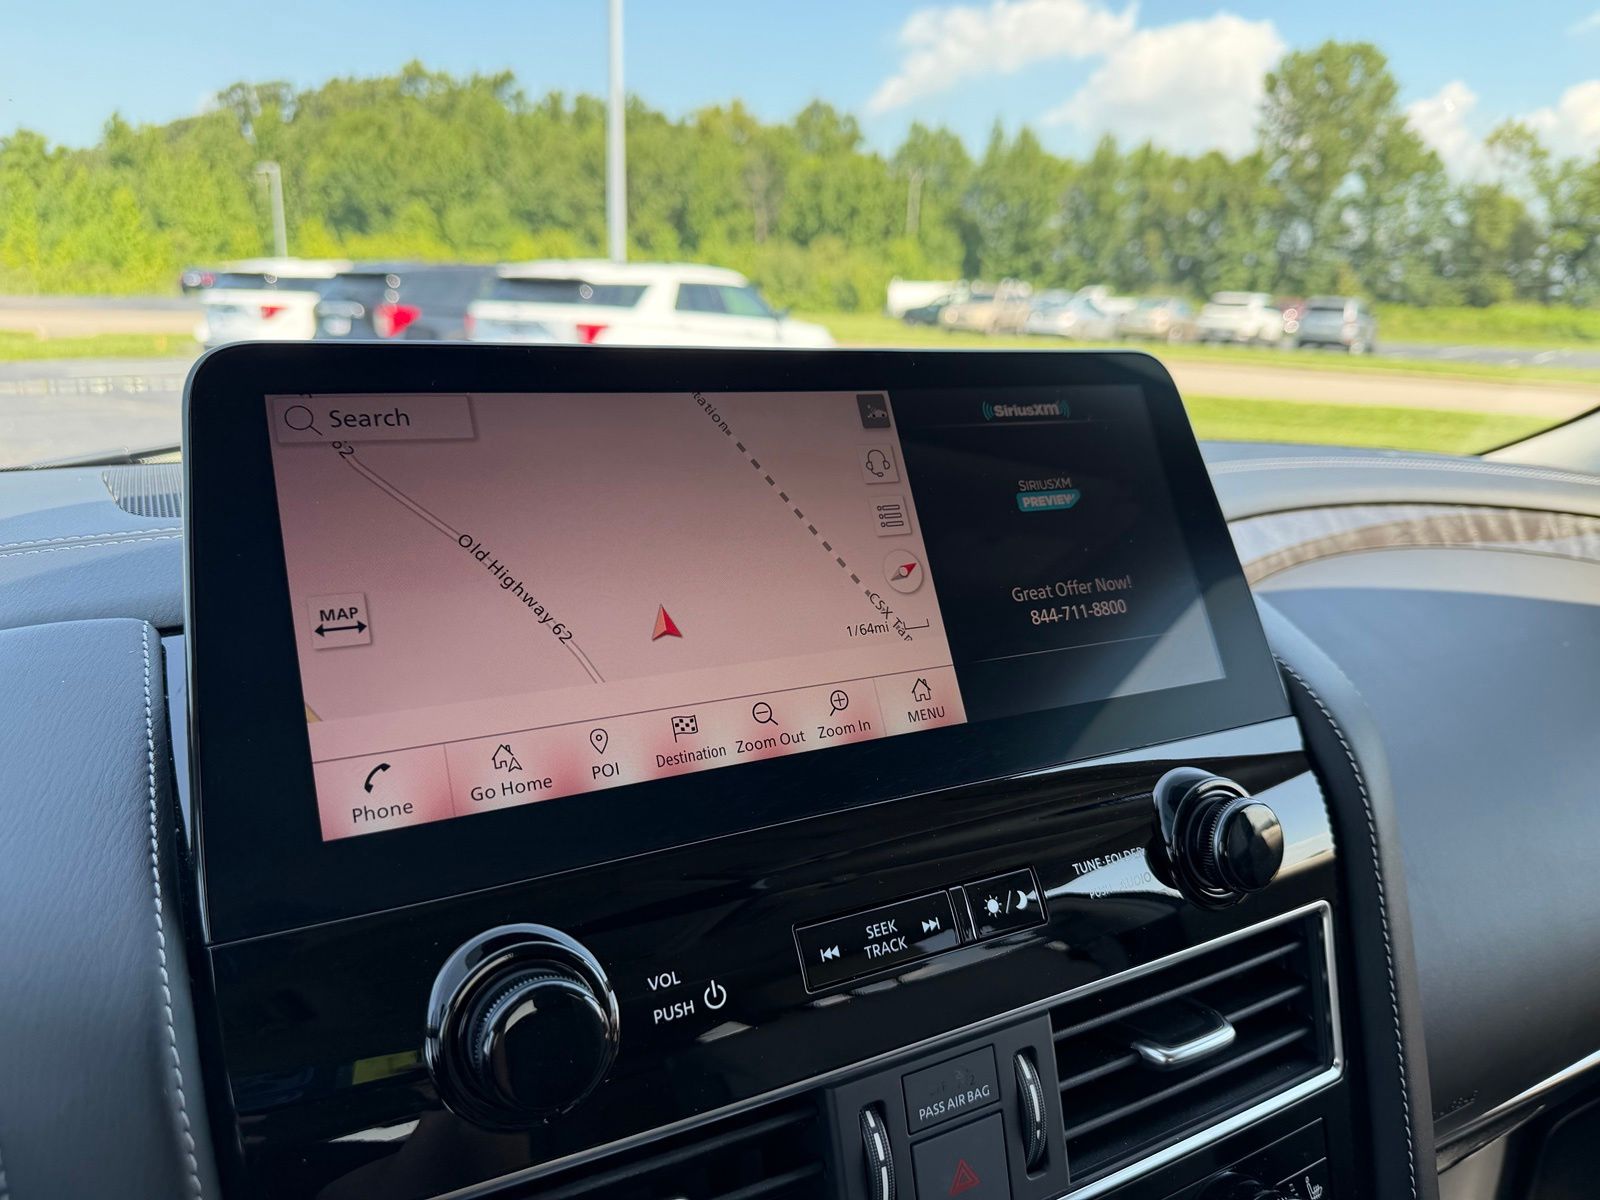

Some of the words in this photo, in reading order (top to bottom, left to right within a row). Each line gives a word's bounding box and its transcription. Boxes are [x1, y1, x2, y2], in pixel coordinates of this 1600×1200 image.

[329, 408, 411, 429] Search
[1018, 477, 1073, 492] SIRIUSXM
[1022, 493, 1076, 508] PREVIEW
[458, 534, 491, 562] Old
[487, 559, 554, 624] Highway
[552, 623, 573, 645] 62
[1011, 585, 1054, 602] Great
[1055, 579, 1092, 597] Offer
[1095, 574, 1133, 592] Now!
[319, 606, 359, 622] MAP
[869, 592, 894, 620] CSX
[1030, 598, 1127, 625] 844-711-8800
[846, 620, 890, 637] 1/64mi
[907, 705, 946, 724] MENU
[817, 722, 857, 739] Zoom
[858, 719, 872, 733] In
[735, 738, 777, 754] Zoom
[779, 730, 807, 746] Out
[656, 744, 727, 768] Destination
[591, 762, 621, 780] POI
[470, 786, 497, 802] Go
[501, 777, 553, 797] Home
[352, 802, 414, 823] Phone
[865, 919, 898, 939] SEEK
[863, 936, 908, 961] TRACK
[647, 971, 682, 991] VOL
[653, 1000, 695, 1024] PUSH
[918, 1100, 946, 1120] PASS
[947, 1093, 966, 1111] AIR
[967, 1084, 991, 1103] BAG
